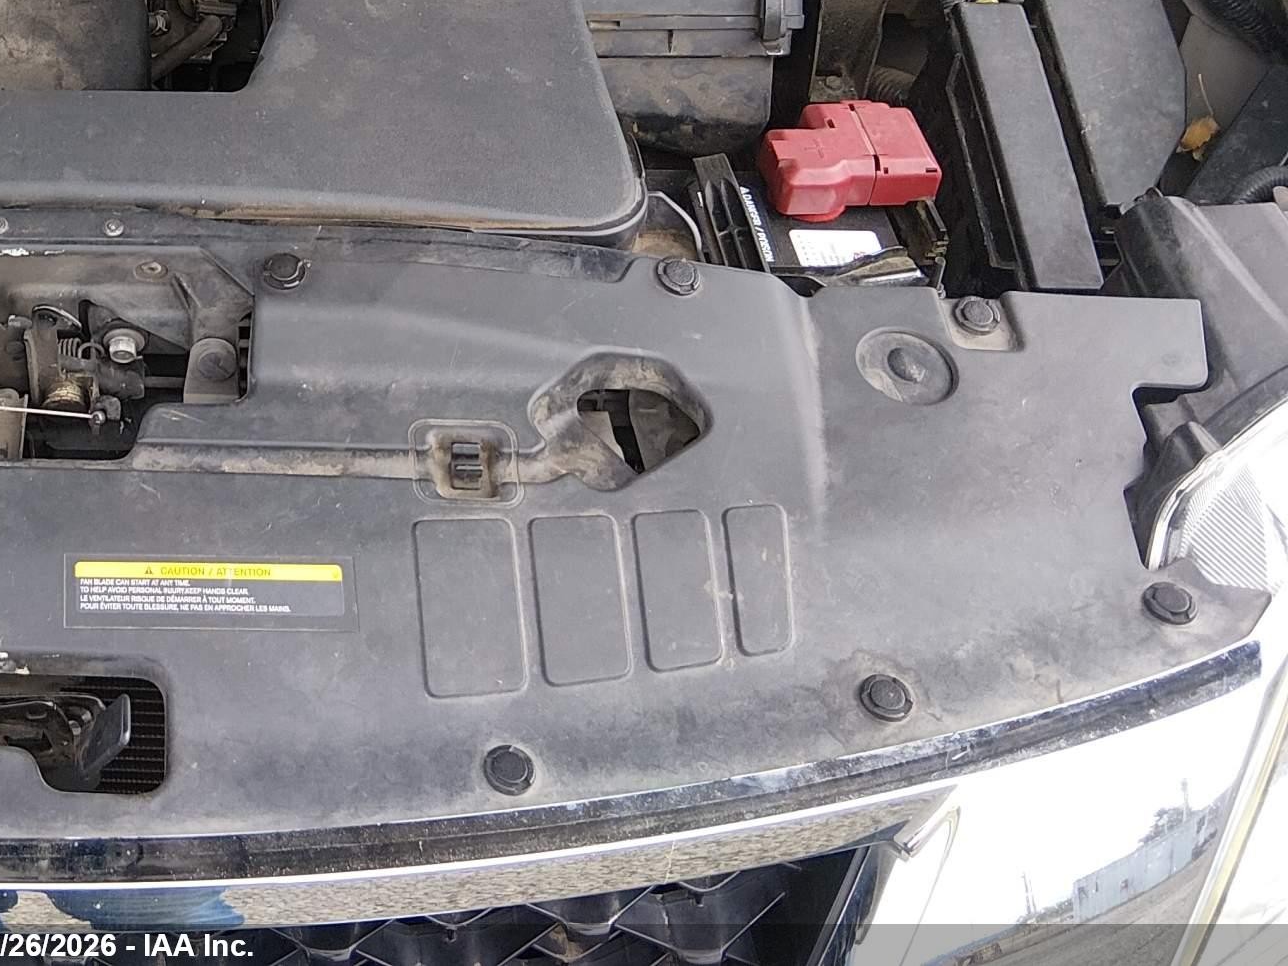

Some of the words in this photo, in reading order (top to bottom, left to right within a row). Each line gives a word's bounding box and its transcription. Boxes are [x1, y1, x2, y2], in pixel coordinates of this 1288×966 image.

[742, 194, 762, 227] DANGER
[757, 232, 775, 262] POISON
[160, 566, 205, 576] CAUTION
[80, 578, 93, 586] FAN
[94, 578, 115, 586] BLADE
[90, 586, 107, 594] HELP
[108, 586, 127, 594] AVOID
[128, 586, 162, 594] PERSONAL
[80, 594, 88, 602] LE
[89, 594, 130, 602] VENTILATEUR
[166, 594, 202, 604] DÉMARRER
[208, 596, 225, 604] TOUT
[80, 602, 99, 610] POUR
[100, 602, 122, 610] ÉVITER
[214, 604, 256, 612] APPROCHER
